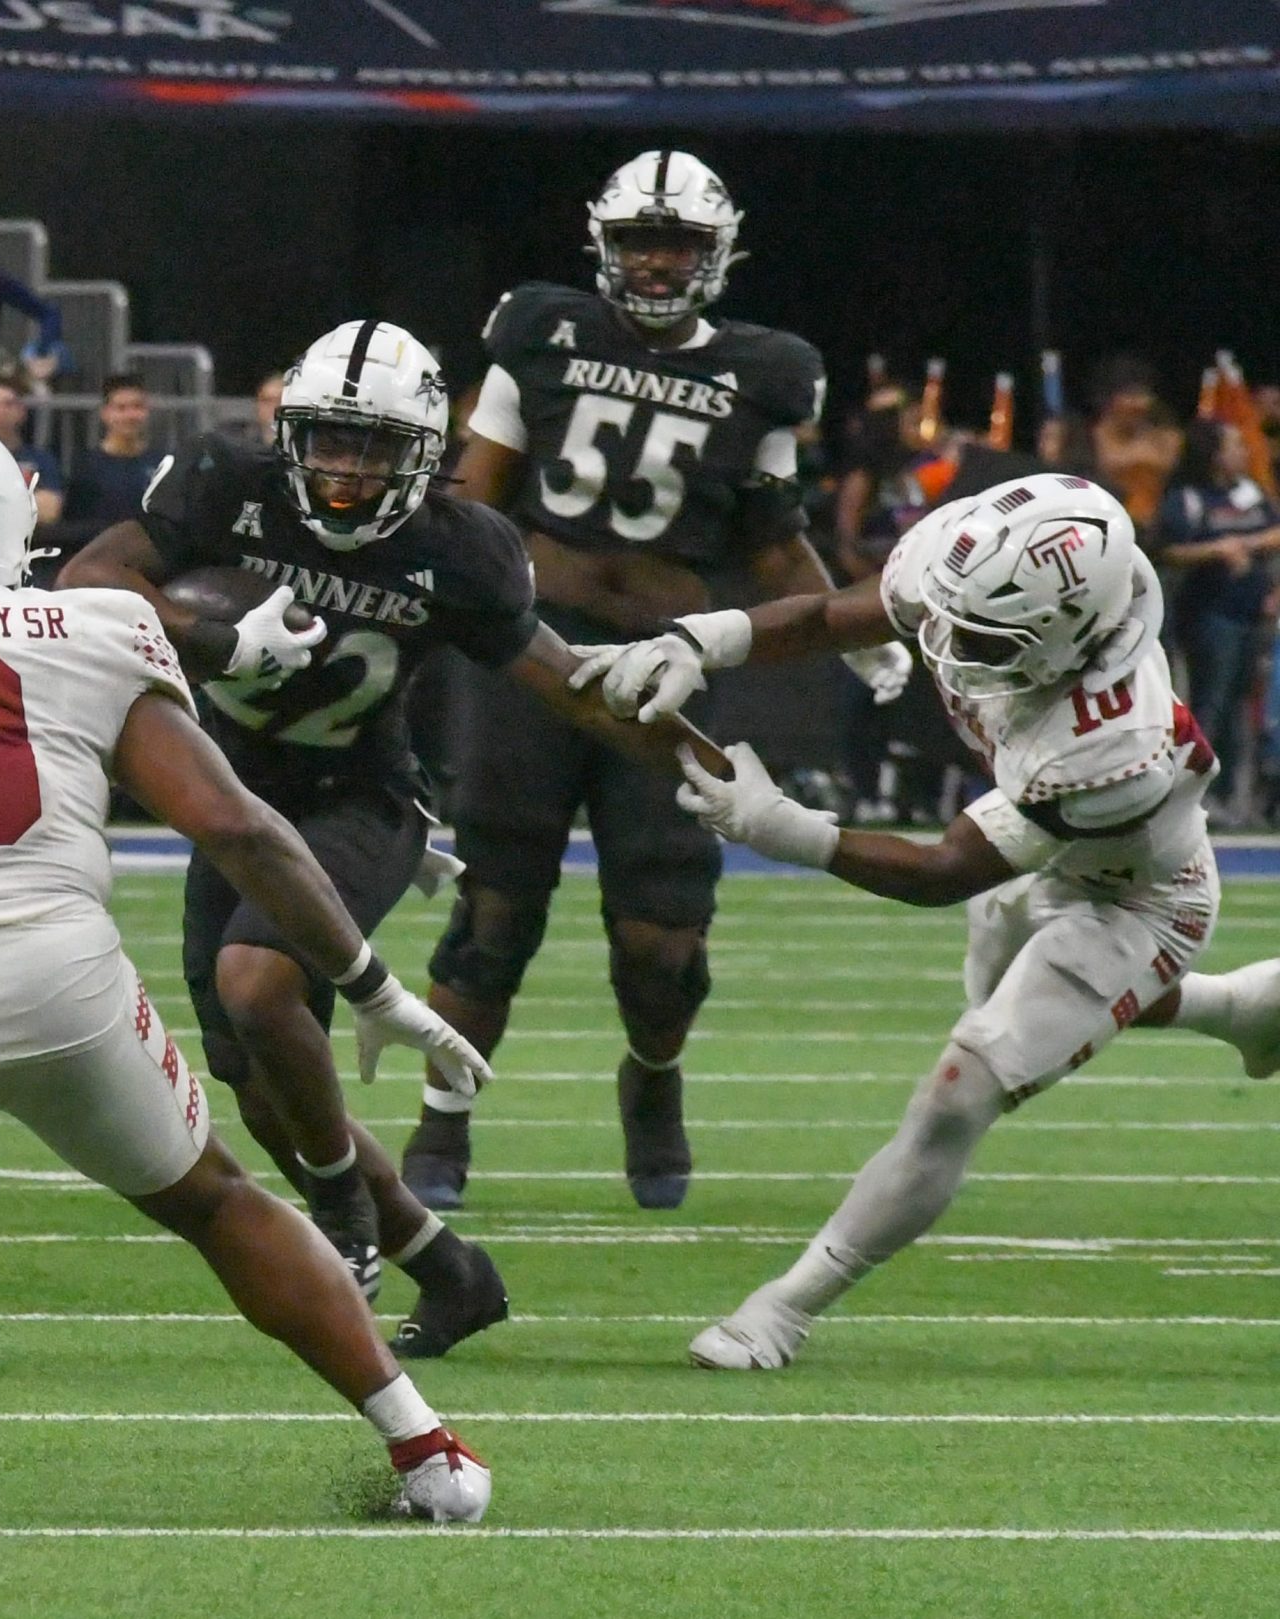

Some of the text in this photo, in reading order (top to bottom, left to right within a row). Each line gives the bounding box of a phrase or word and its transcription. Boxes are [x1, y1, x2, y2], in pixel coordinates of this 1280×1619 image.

[562, 358, 734, 418] RUNNERS
[540, 394, 711, 541] 55
[23, 607, 69, 639] SR
